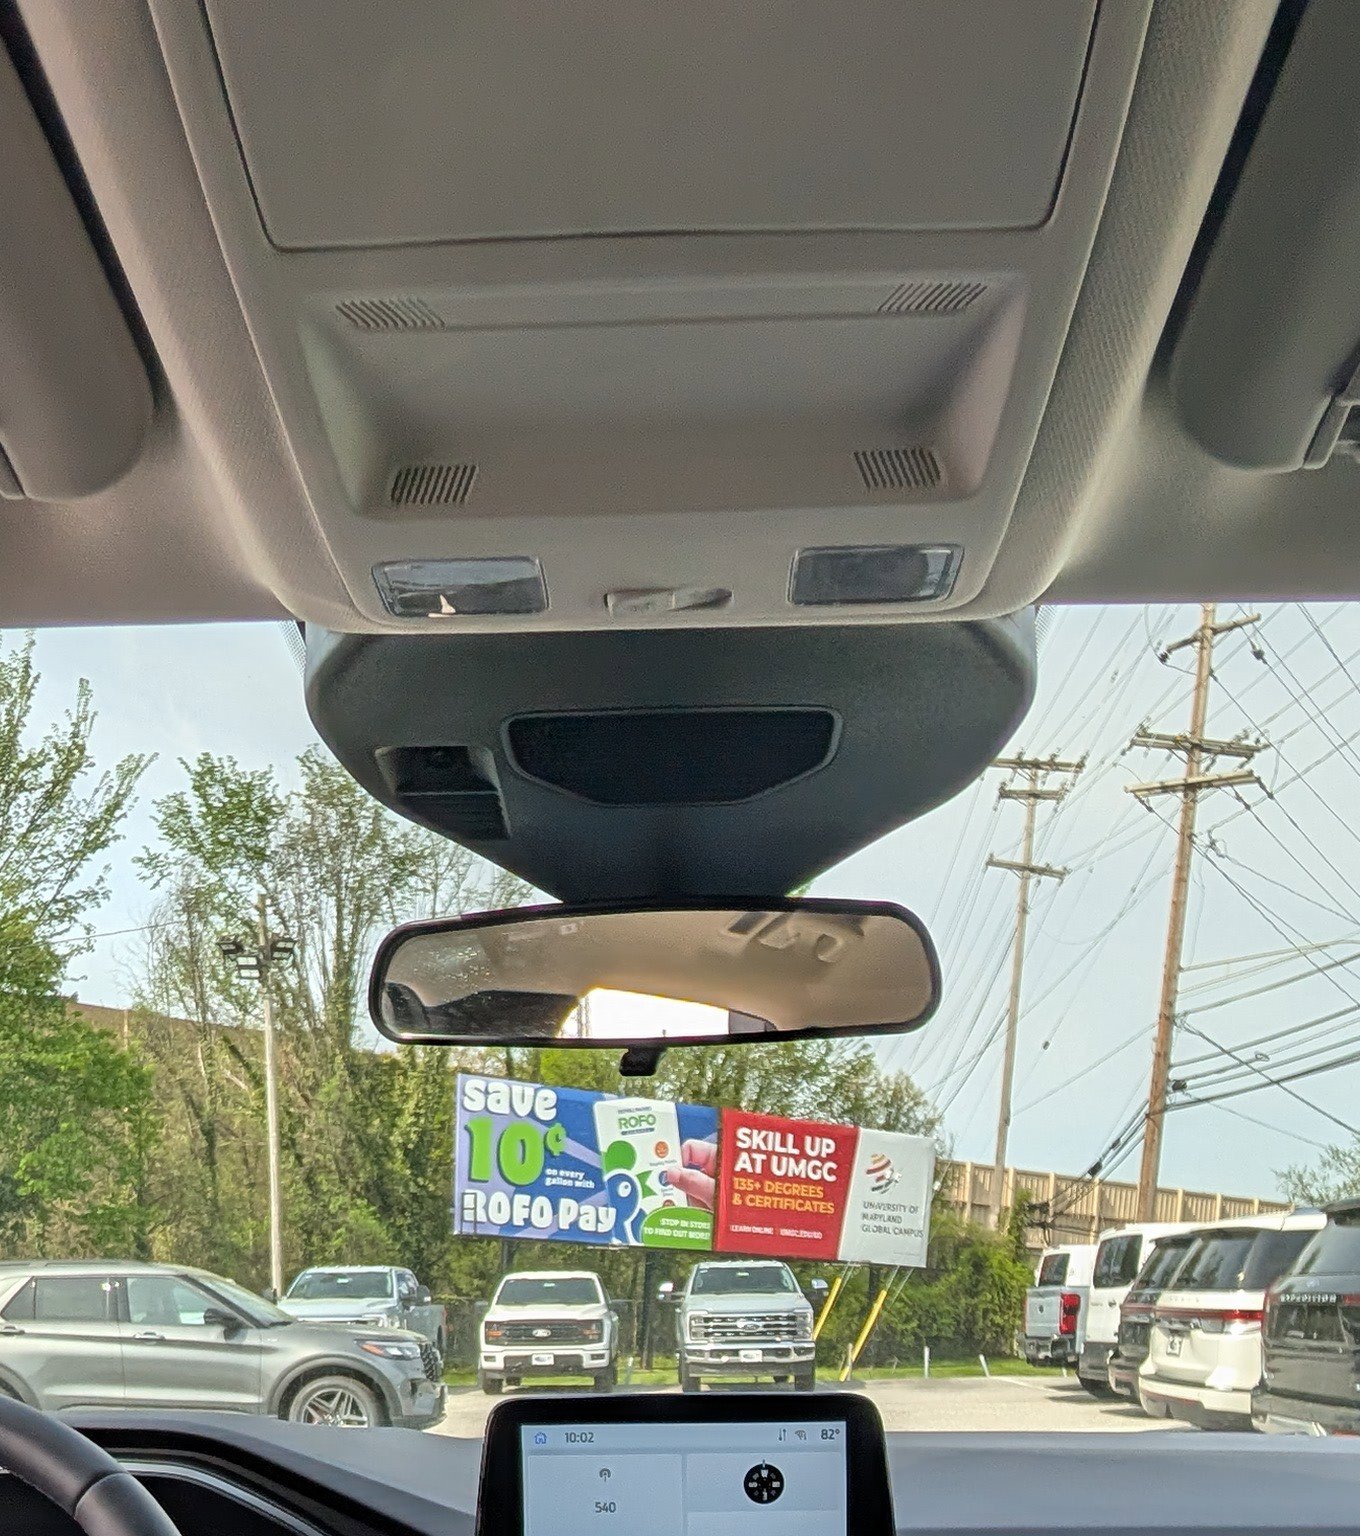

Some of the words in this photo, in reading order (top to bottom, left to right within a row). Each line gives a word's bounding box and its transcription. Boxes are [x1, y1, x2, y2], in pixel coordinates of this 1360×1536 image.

[618, 1113, 657, 1130] ROFO
[735, 1126, 800, 1155] SKILL
[804, 1135, 836, 1158] UP
[545, 1168, 558, 1177] on
[559, 1169, 586, 1181] every
[734, 1151, 767, 1174] AT
[770, 1155, 838, 1182] UMGC
[544, 1177, 574, 1188] gallon
[574, 1179, 596, 1189] with
[732, 1176, 762, 1192] 135+
[764, 1180, 825, 1199] DEGREES
[462, 1188, 554, 1229] ROFO
[558, 1197, 617, 1234] Pay
[744, 1194, 836, 1214] CERTIFICATES
[862, 1201, 908, 1213] UNIVERSITY
[908, 1204, 920, 1215] OF
[861, 1224, 892, 1236] GLOBAL
[892, 1226, 925, 1239] CAMPUS
[564, 1431, 595, 1444] 10:02
[594, 1502, 617, 1514] 540
